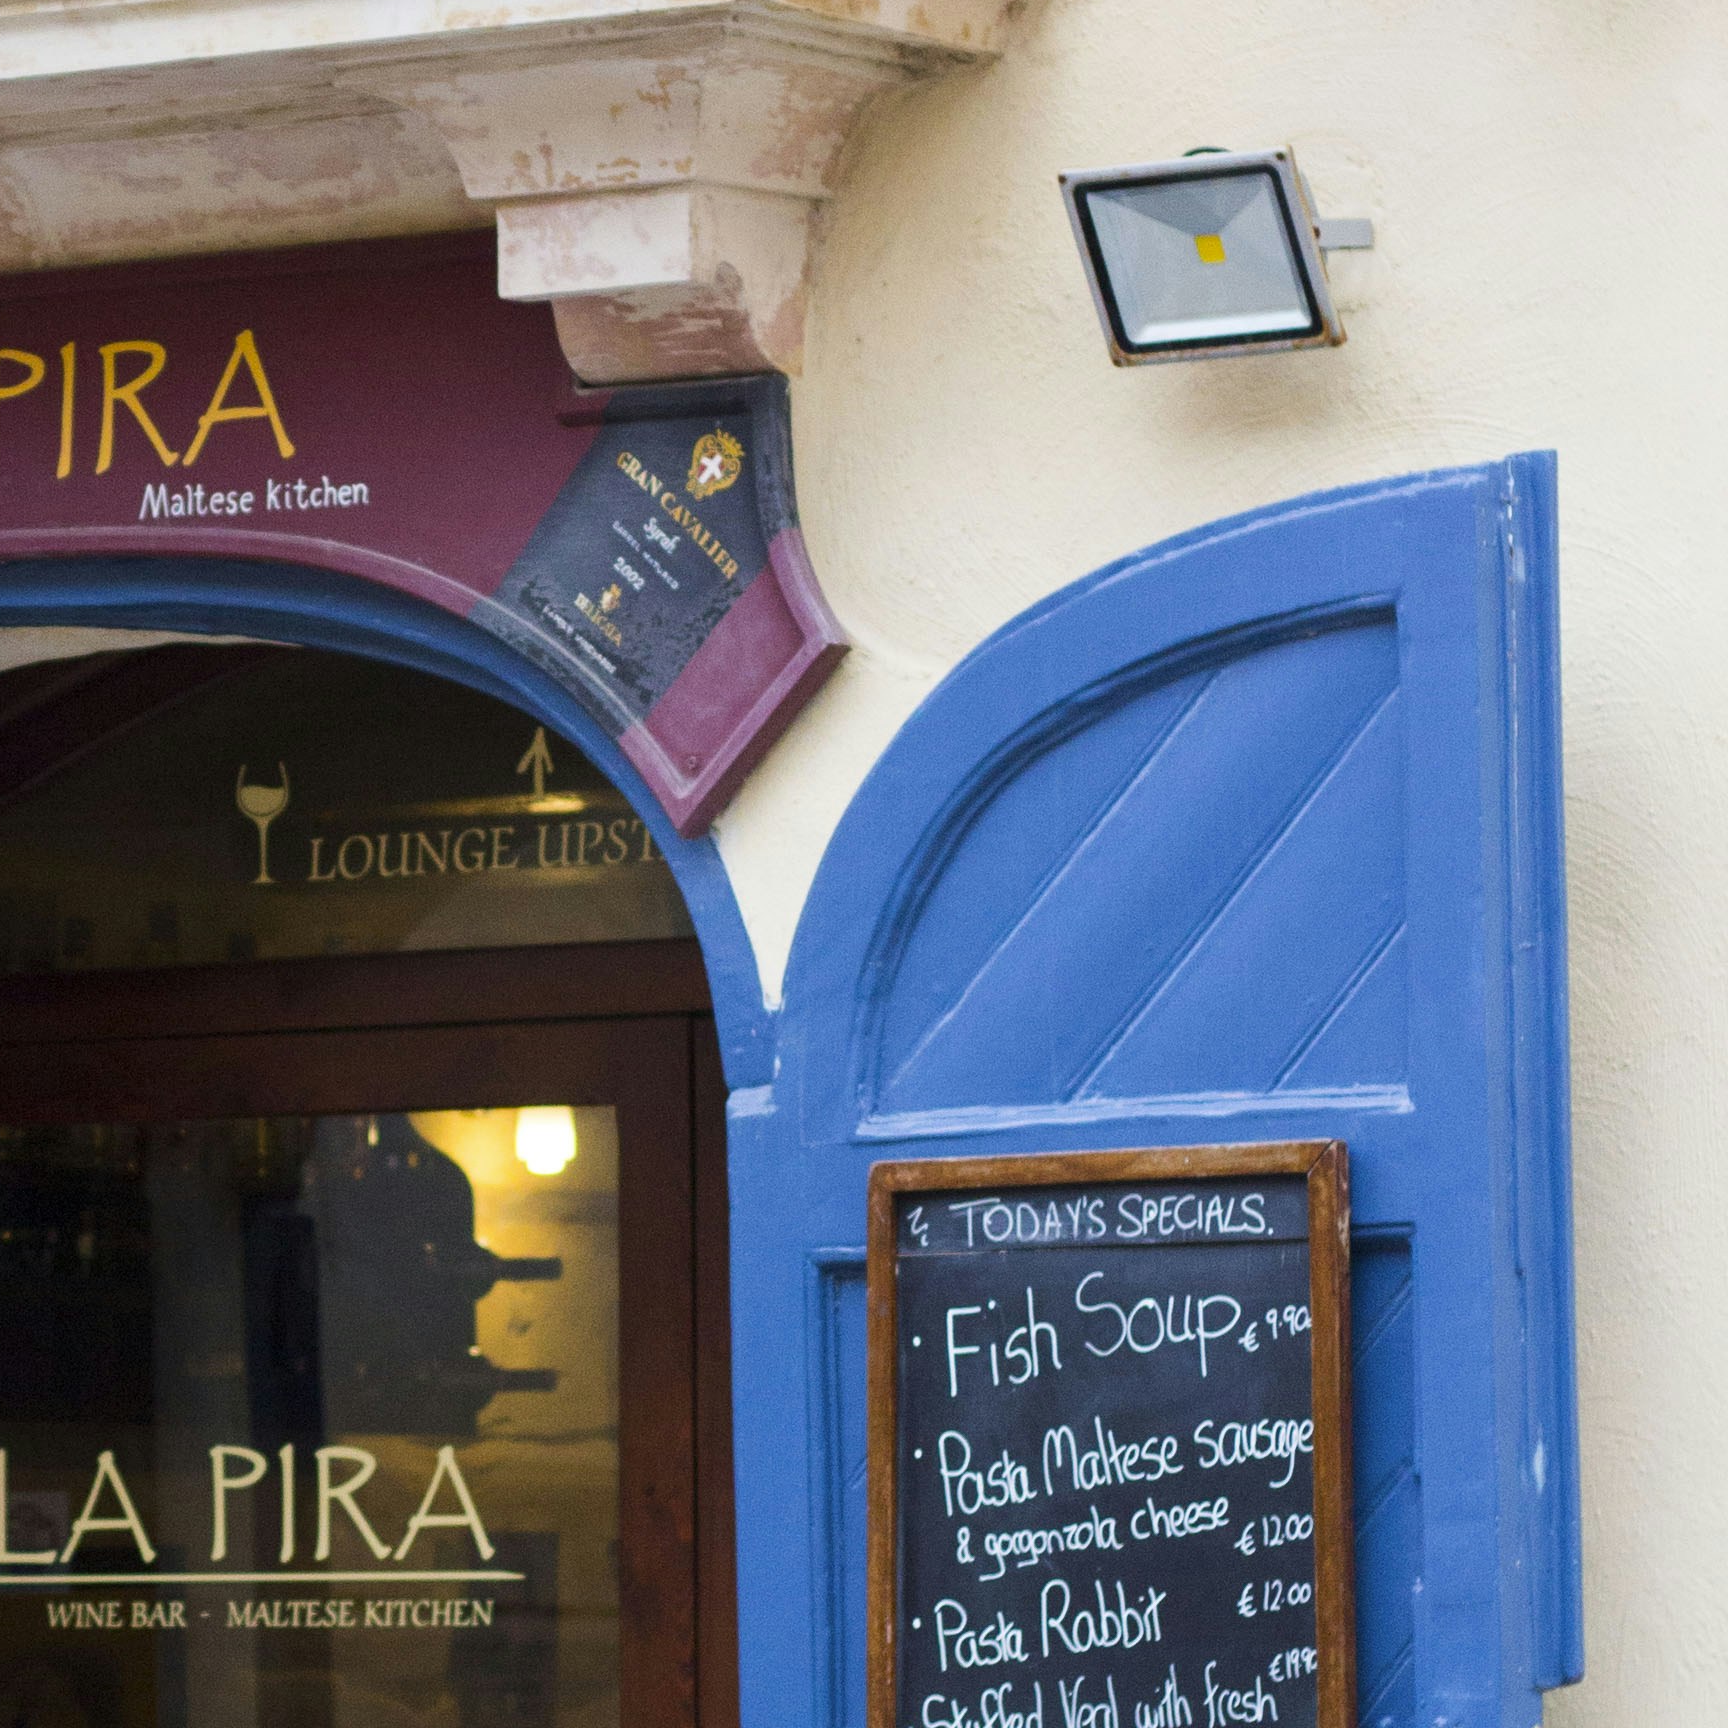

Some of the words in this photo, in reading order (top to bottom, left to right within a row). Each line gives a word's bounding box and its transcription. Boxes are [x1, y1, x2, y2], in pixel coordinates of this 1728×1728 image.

[139, 482, 254, 519] Maltese
[616, 451, 664, 497] GRAN
[661, 492, 739, 579] CAVALIER
[643, 517, 681, 554] Syrah
[613, 556, 645, 591] 2002
[307, 826, 519, 882] LOUNGE
[537, 818, 664, 868] UPST
[949, 1196, 1106, 1247] TODAY'S
[947, 1286, 1062, 1397] Fish
[1076, 1272, 1241, 1378] Soup
[938, 1430, 1037, 1516] Pasta
[1043, 1416, 1184, 1496] Maltese
[210, 1443, 496, 1563] PIRA
[956, 1526, 974, 1564] &
[1131, 1497, 1230, 1540] cheese
[46, 1600, 123, 1629] WINE
[129, 1600, 187, 1629] BAR
[226, 1600, 357, 1628] MALTESE
[363, 1599, 494, 1628] KITCHEN
[934, 1598, 1029, 1672] Pasta
[1041, 1579, 1168, 1658] Rabbit
